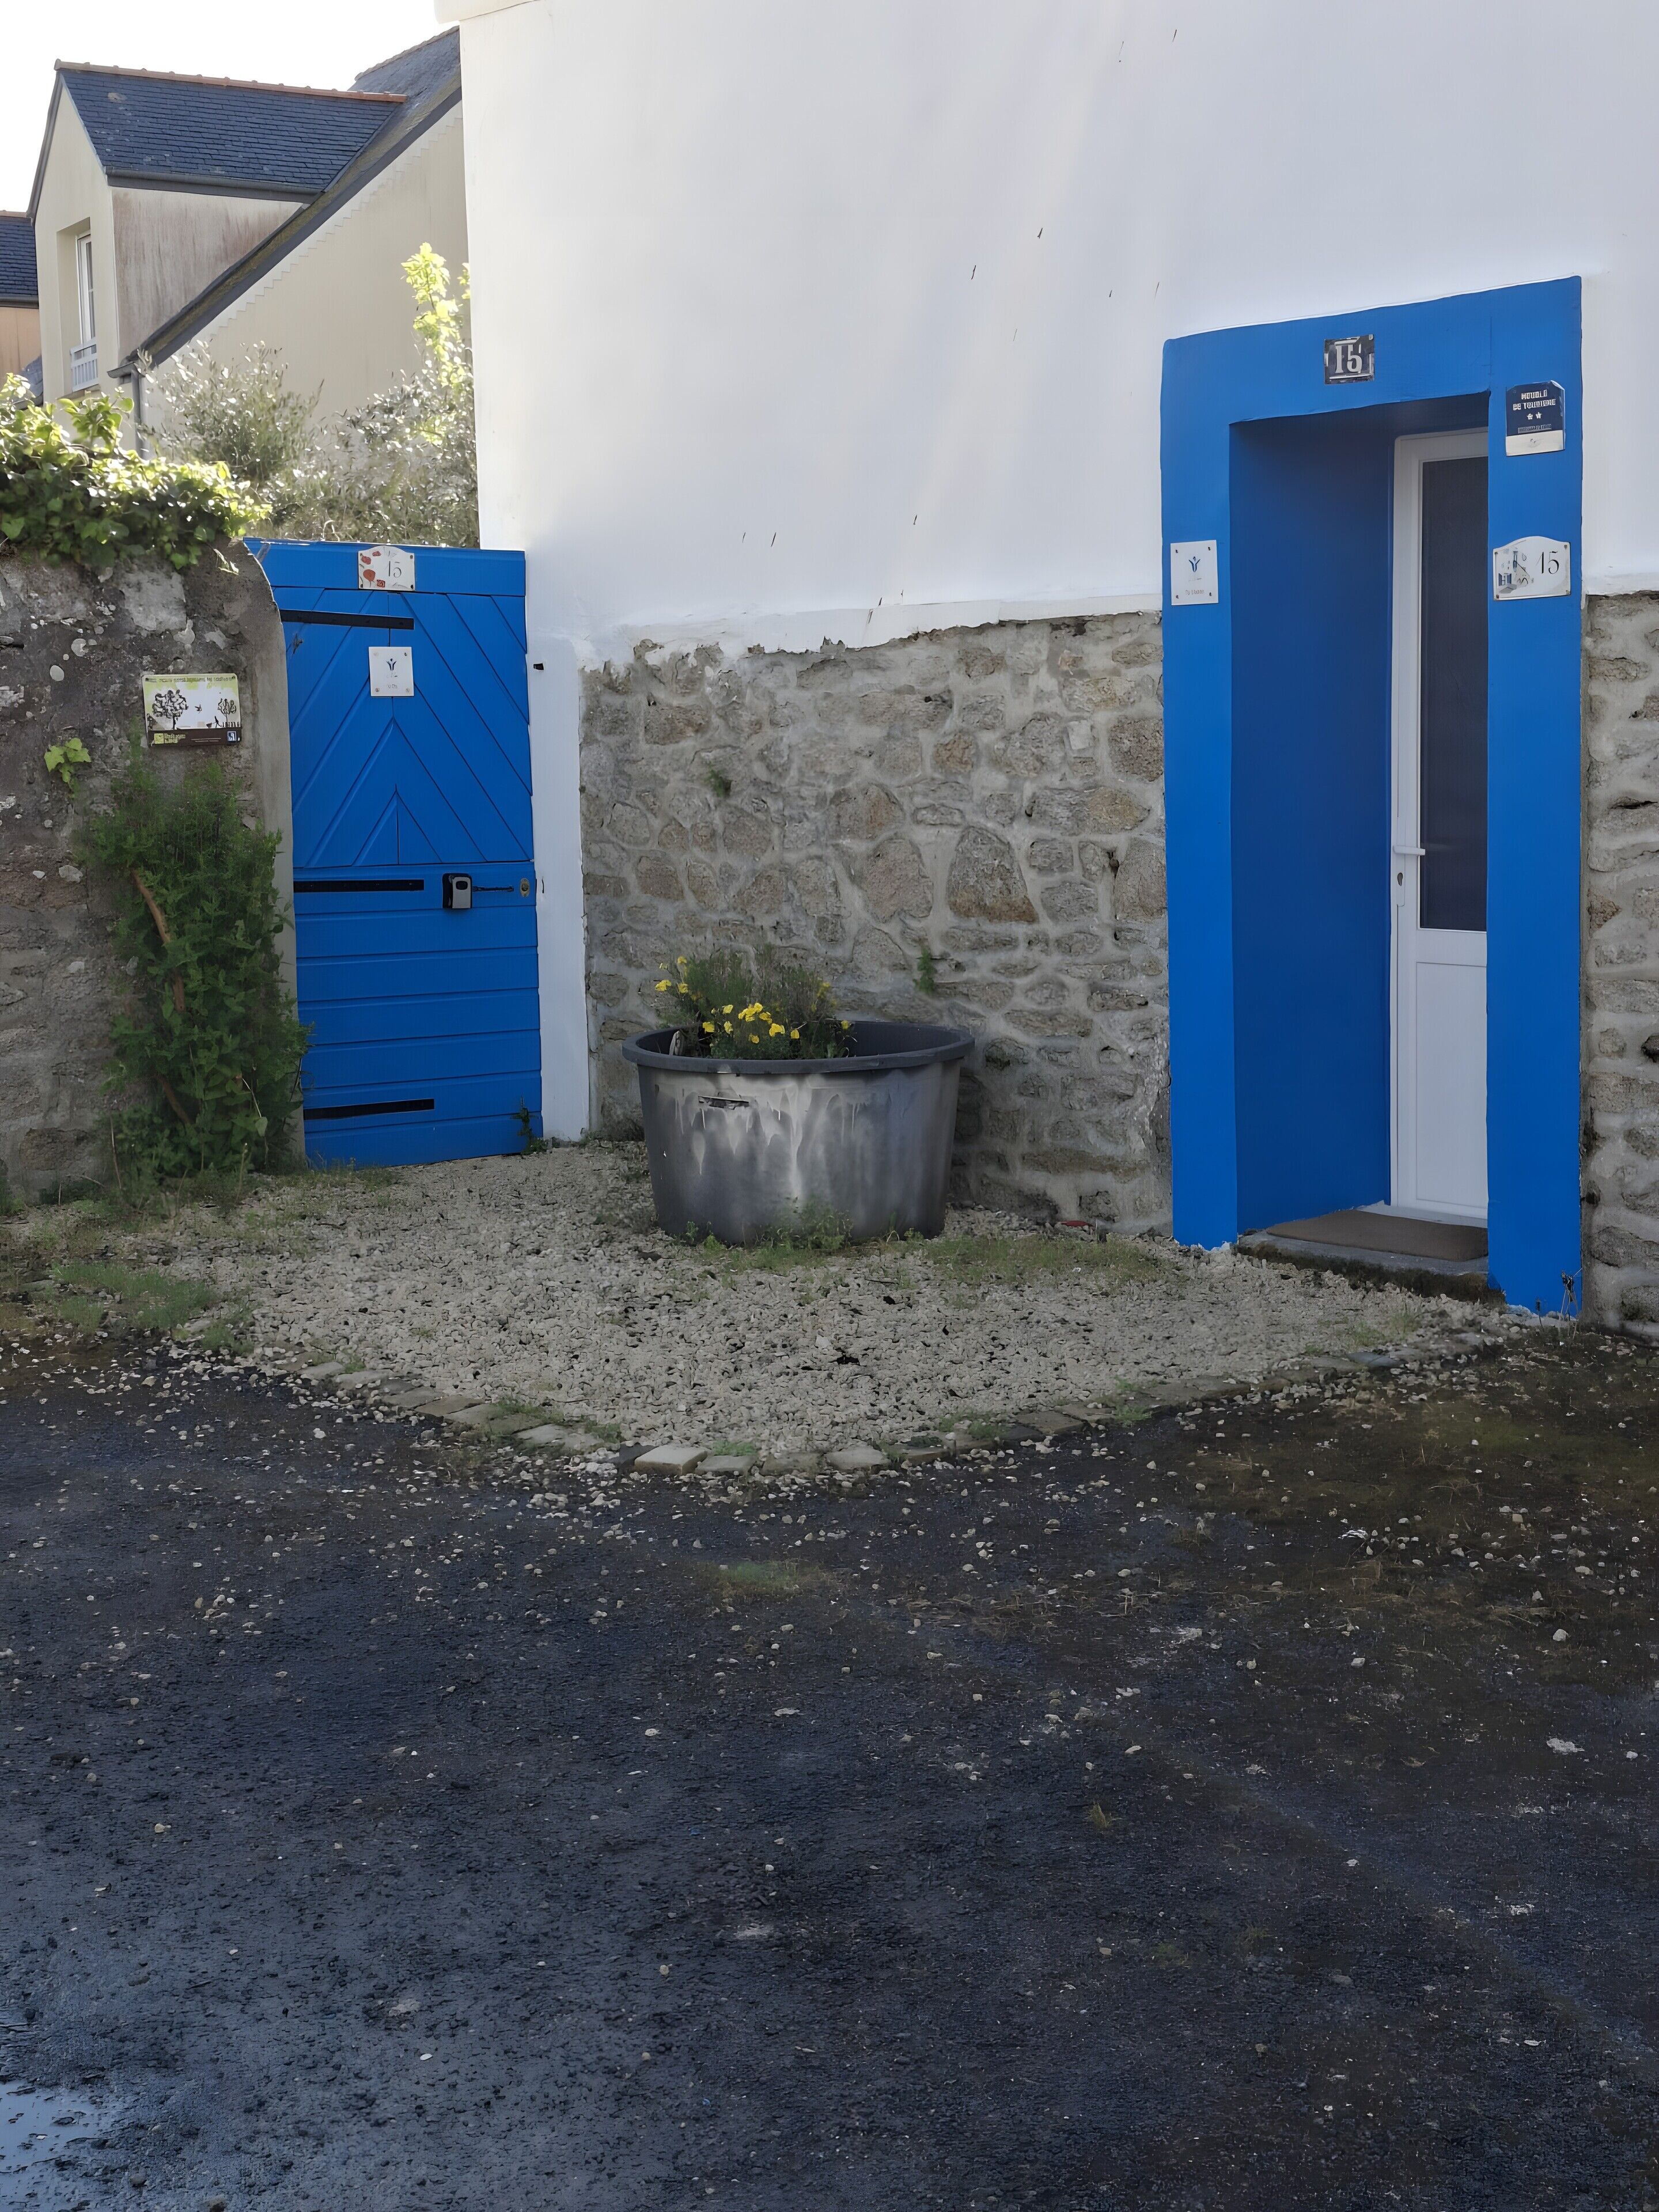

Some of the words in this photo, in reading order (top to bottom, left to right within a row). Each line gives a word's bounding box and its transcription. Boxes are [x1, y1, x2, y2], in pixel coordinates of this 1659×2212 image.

[1335, 344, 1362, 373] 15
[384, 560, 402, 578] 15
[1536, 551, 1559, 574] 15
